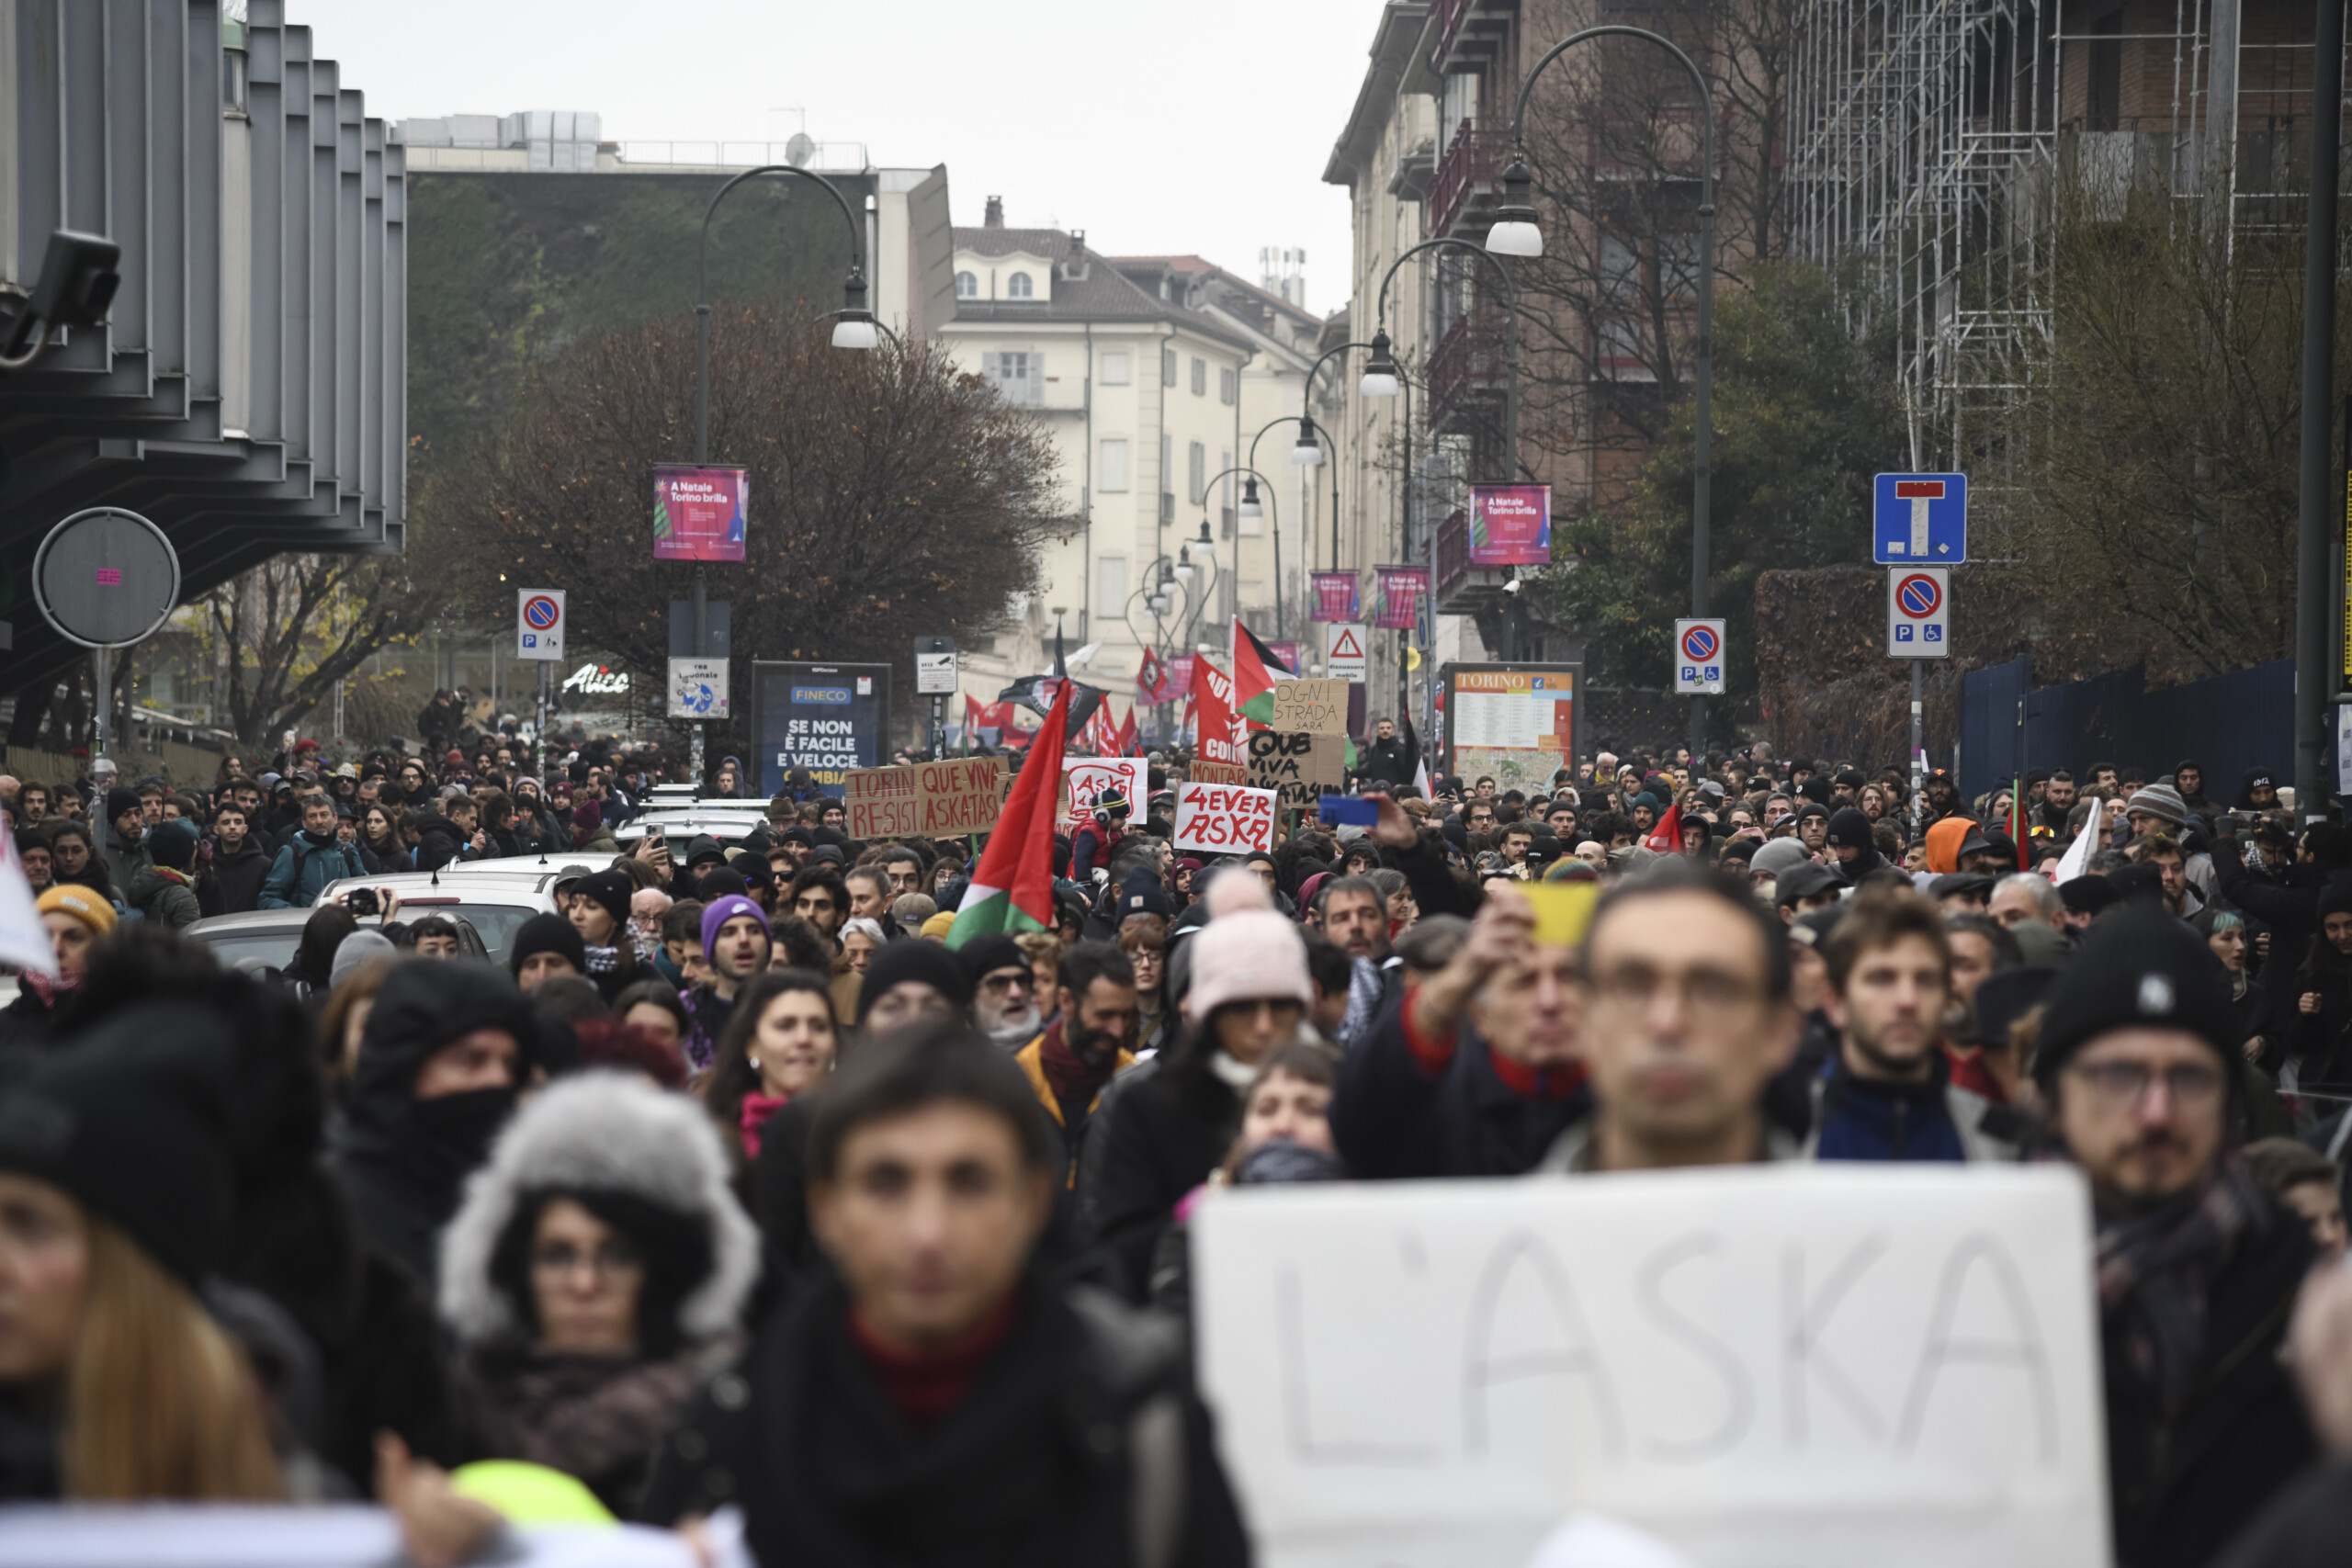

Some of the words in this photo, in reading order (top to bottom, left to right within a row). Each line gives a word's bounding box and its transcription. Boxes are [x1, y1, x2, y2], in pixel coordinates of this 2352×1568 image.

[671, 481, 679, 491] A
[680, 482, 713, 492] Natale
[671, 492, 702, 502] Torino
[703, 493, 728, 503] brilla
[1488, 497, 1495, 506] A
[1496, 498, 1524, 506] Natale
[1488, 506, 1514, 514] Torino
[1515, 507, 1537, 515] brilla
[561, 663, 629, 694] Alice
[1457, 673, 1524, 689] TORINO
[796, 690, 847, 701] FINECO
[1276, 682, 1330, 703] OGNI
[1274, 704, 1338, 720] STRADA
[788, 719, 808, 734] SE
[812, 720, 853, 734] NON
[785, 733, 795, 750] È
[798, 737, 855, 751] FACILE
[1249, 731, 1312, 757] QUE
[777, 753, 787, 767] E
[791, 753, 863, 769] VELOCE,
[1250, 756, 1300, 780] VIVA
[922, 766, 963, 794] QUE
[966, 761, 1001, 792] VIVA
[1183, 786, 1271, 816] 4EVER
[1179, 813, 1270, 852] ASKA
[1273, 1223, 2061, 1472] L'ASKA
